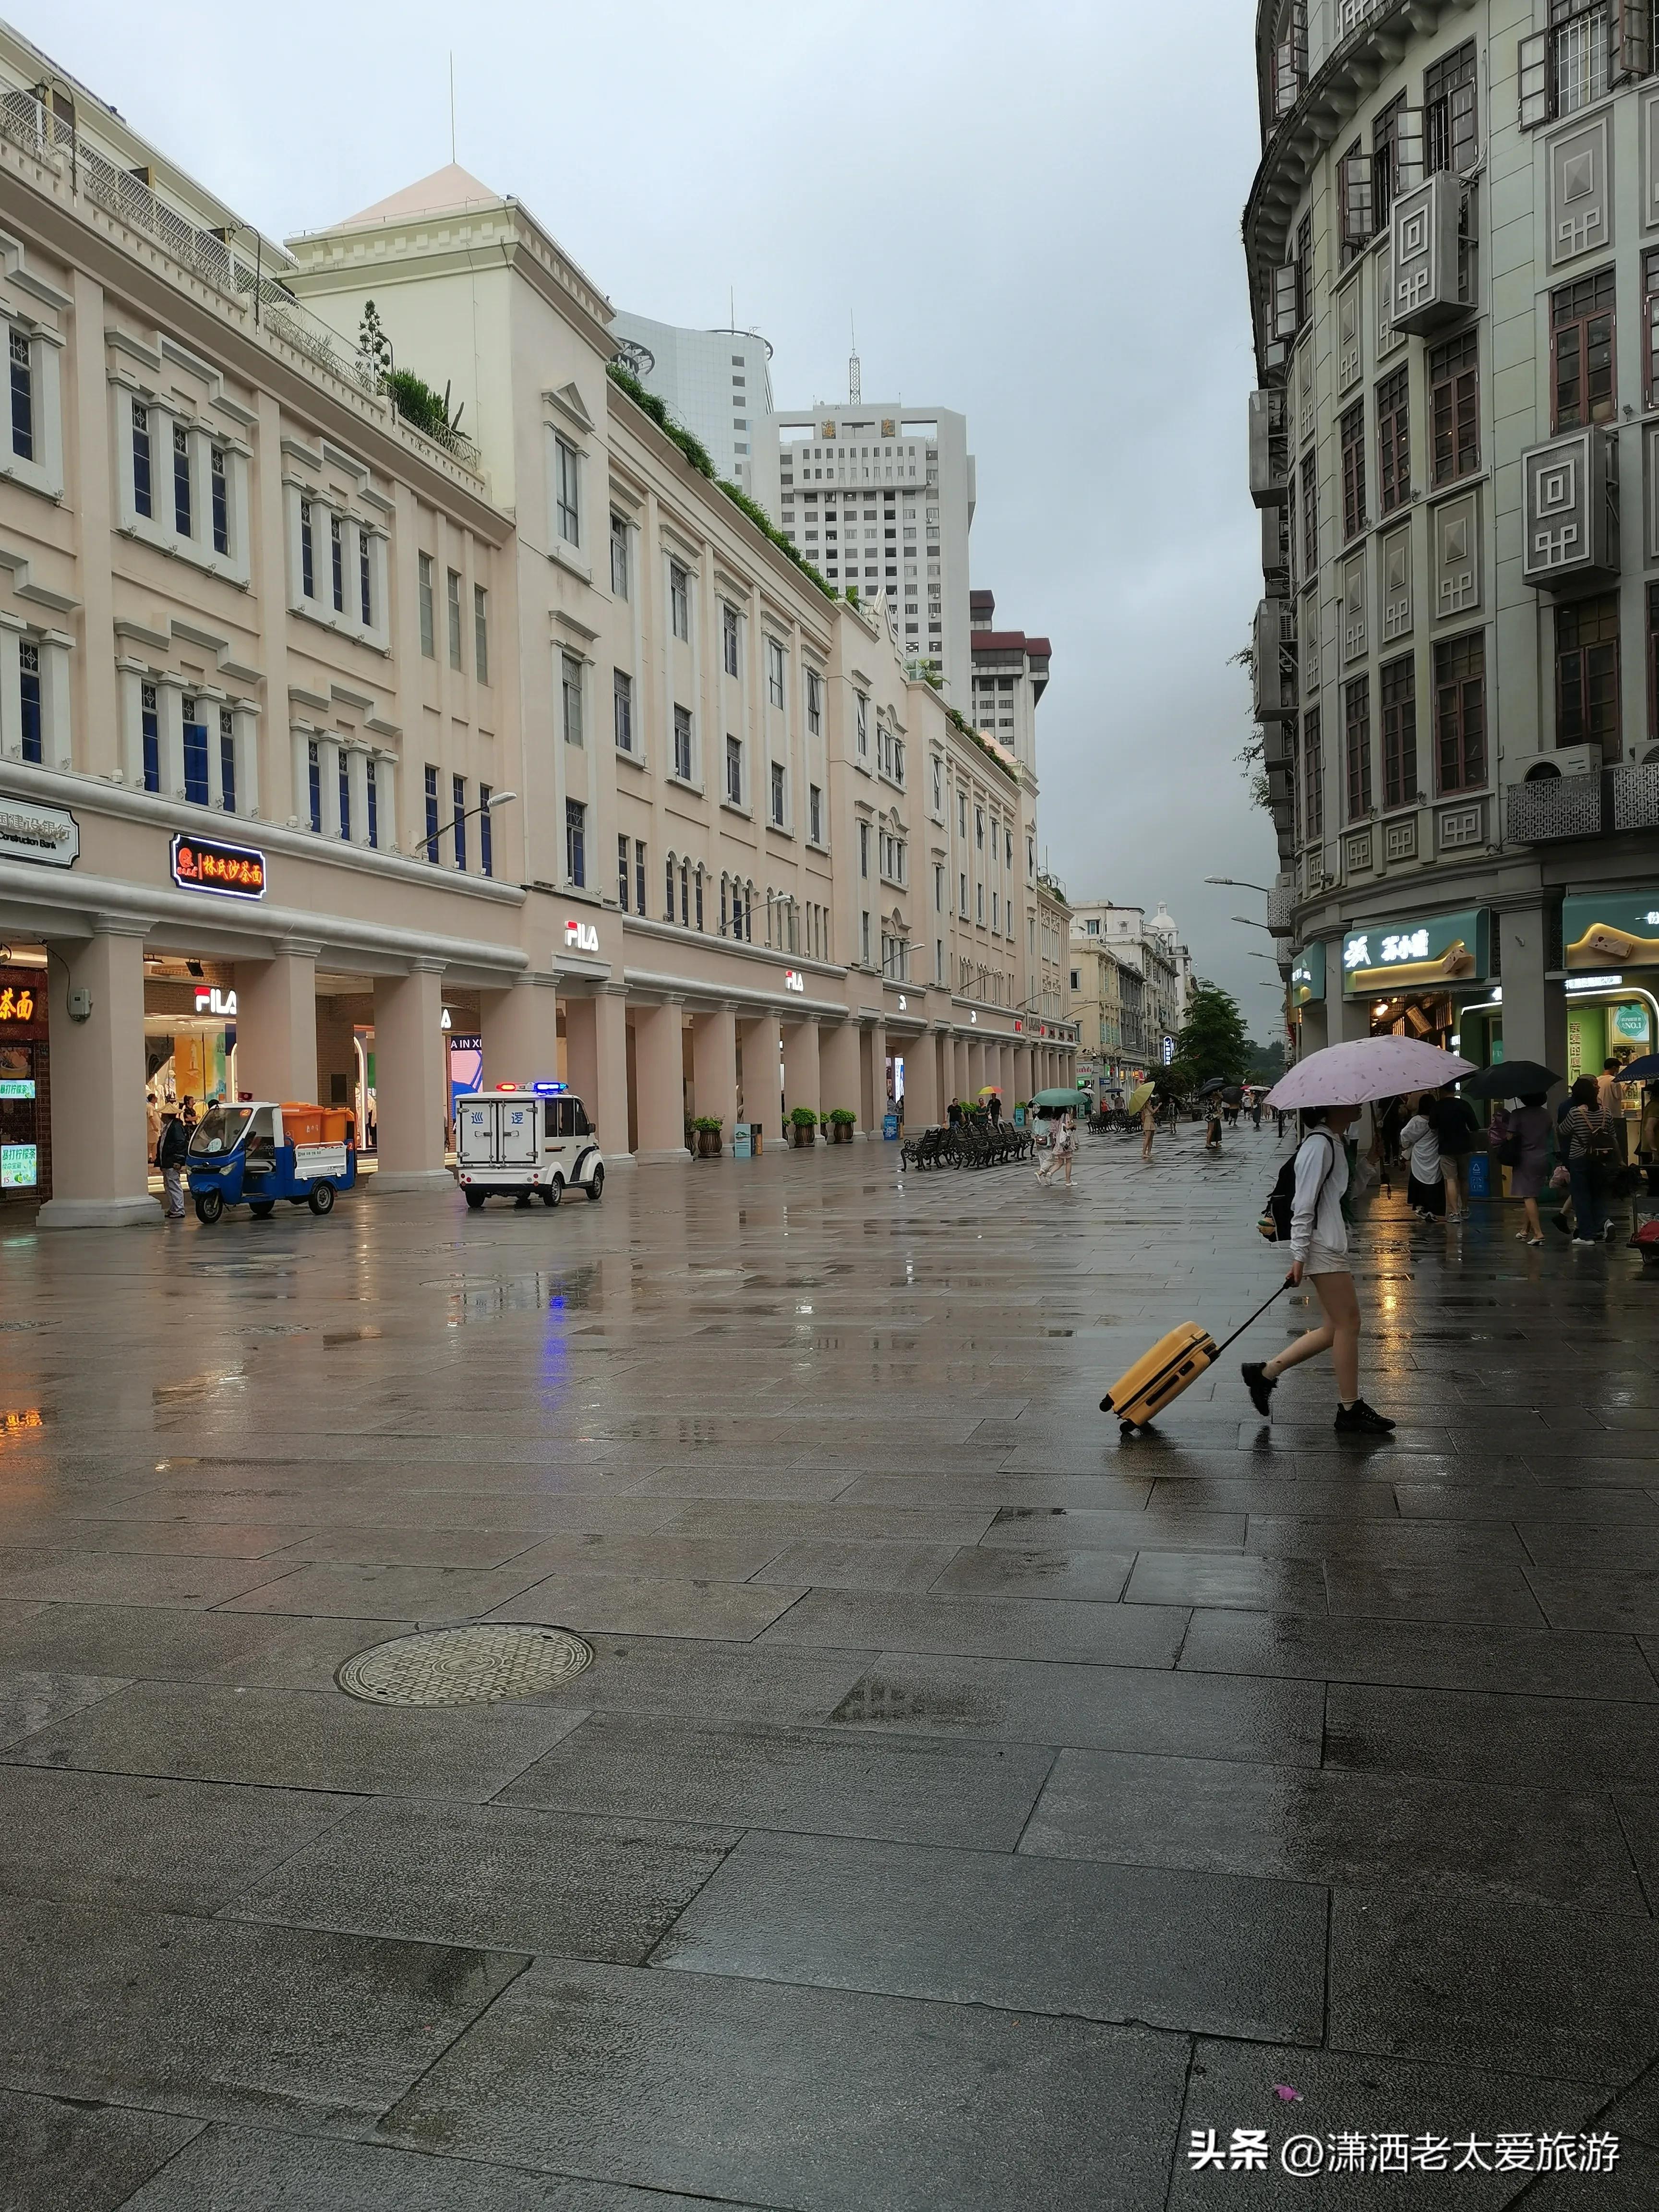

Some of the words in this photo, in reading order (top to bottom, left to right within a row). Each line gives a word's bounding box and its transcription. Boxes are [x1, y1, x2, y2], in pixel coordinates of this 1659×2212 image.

[40, 839, 56, 849] Bank
[565, 920, 599, 951] FILA
[785, 971, 804, 991] FILA
[194, 986, 237, 1014] FILA
[459, 1039, 470, 1048] IN
[2, 1148, 36, 1160] 暴打柠檬茶
